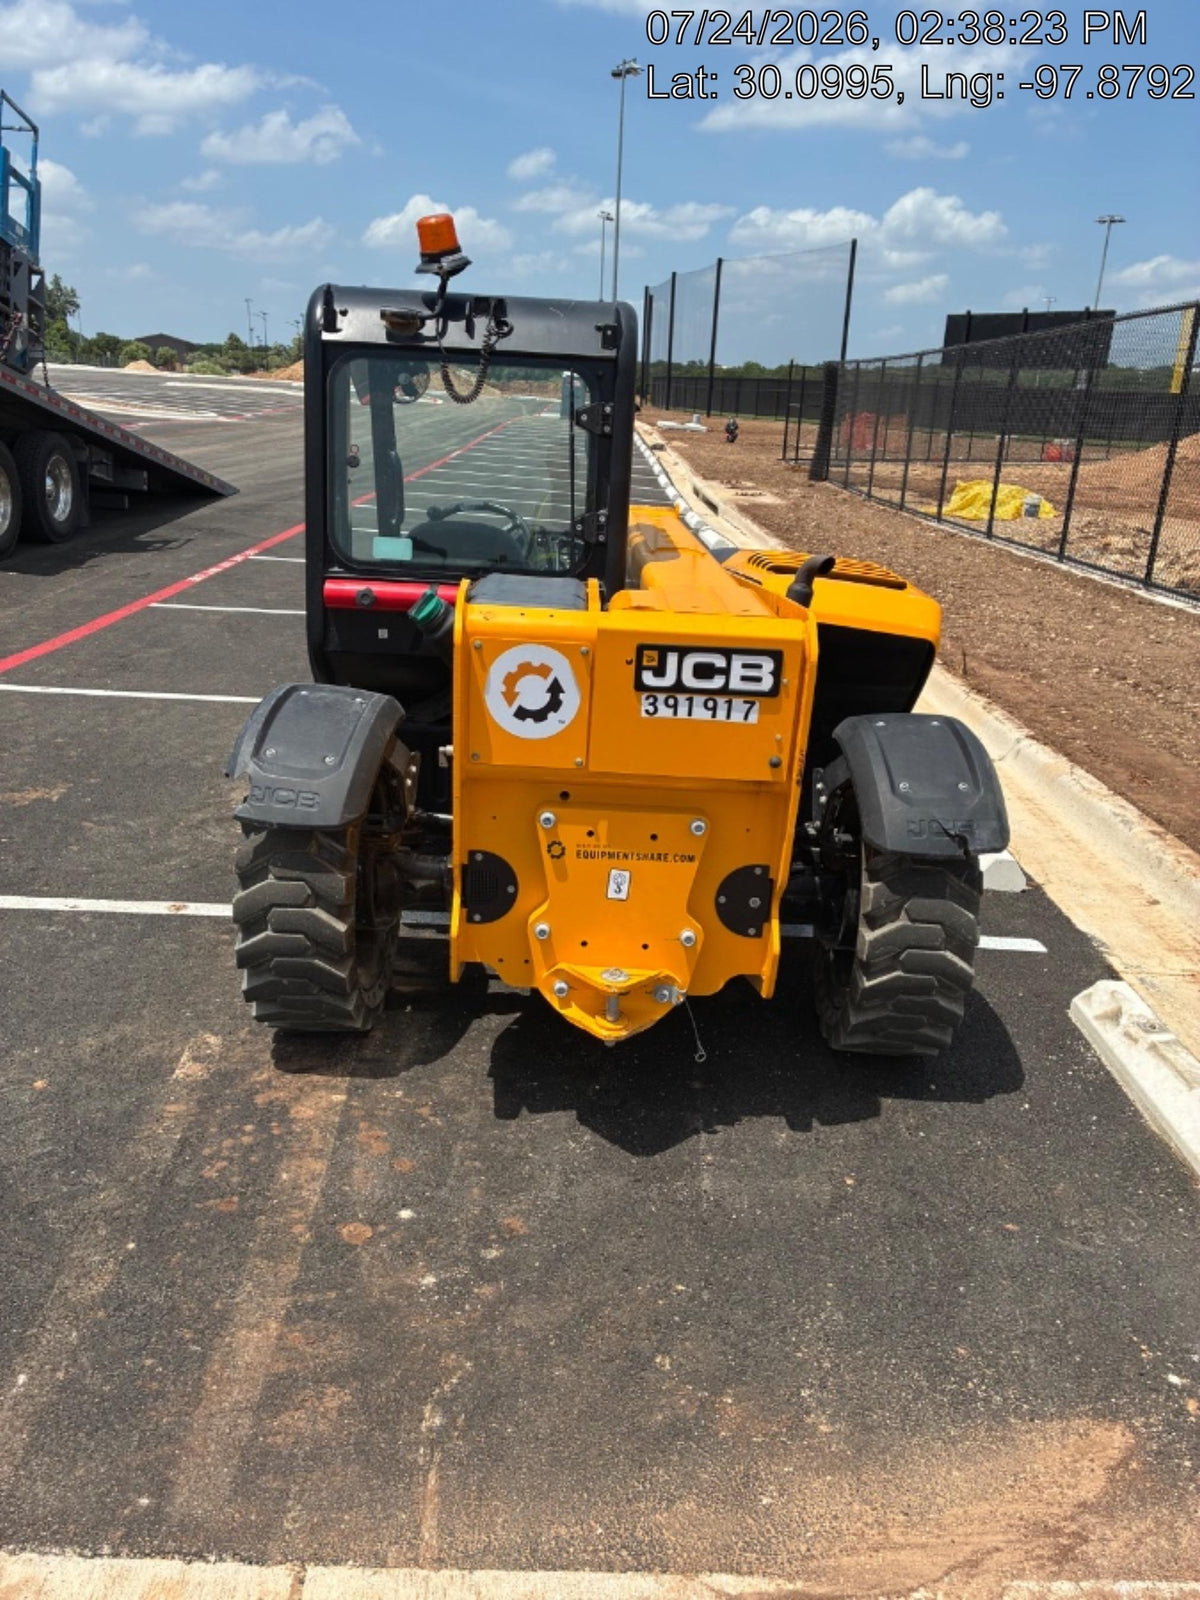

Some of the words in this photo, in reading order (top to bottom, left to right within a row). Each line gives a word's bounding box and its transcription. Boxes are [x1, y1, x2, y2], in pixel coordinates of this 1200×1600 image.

[641, 651, 775, 692] JCB
[644, 694, 757, 722] 391917
[250, 785, 320, 812] JCB
[575, 849, 696, 863] EQUIPMENTSHARE.COM
